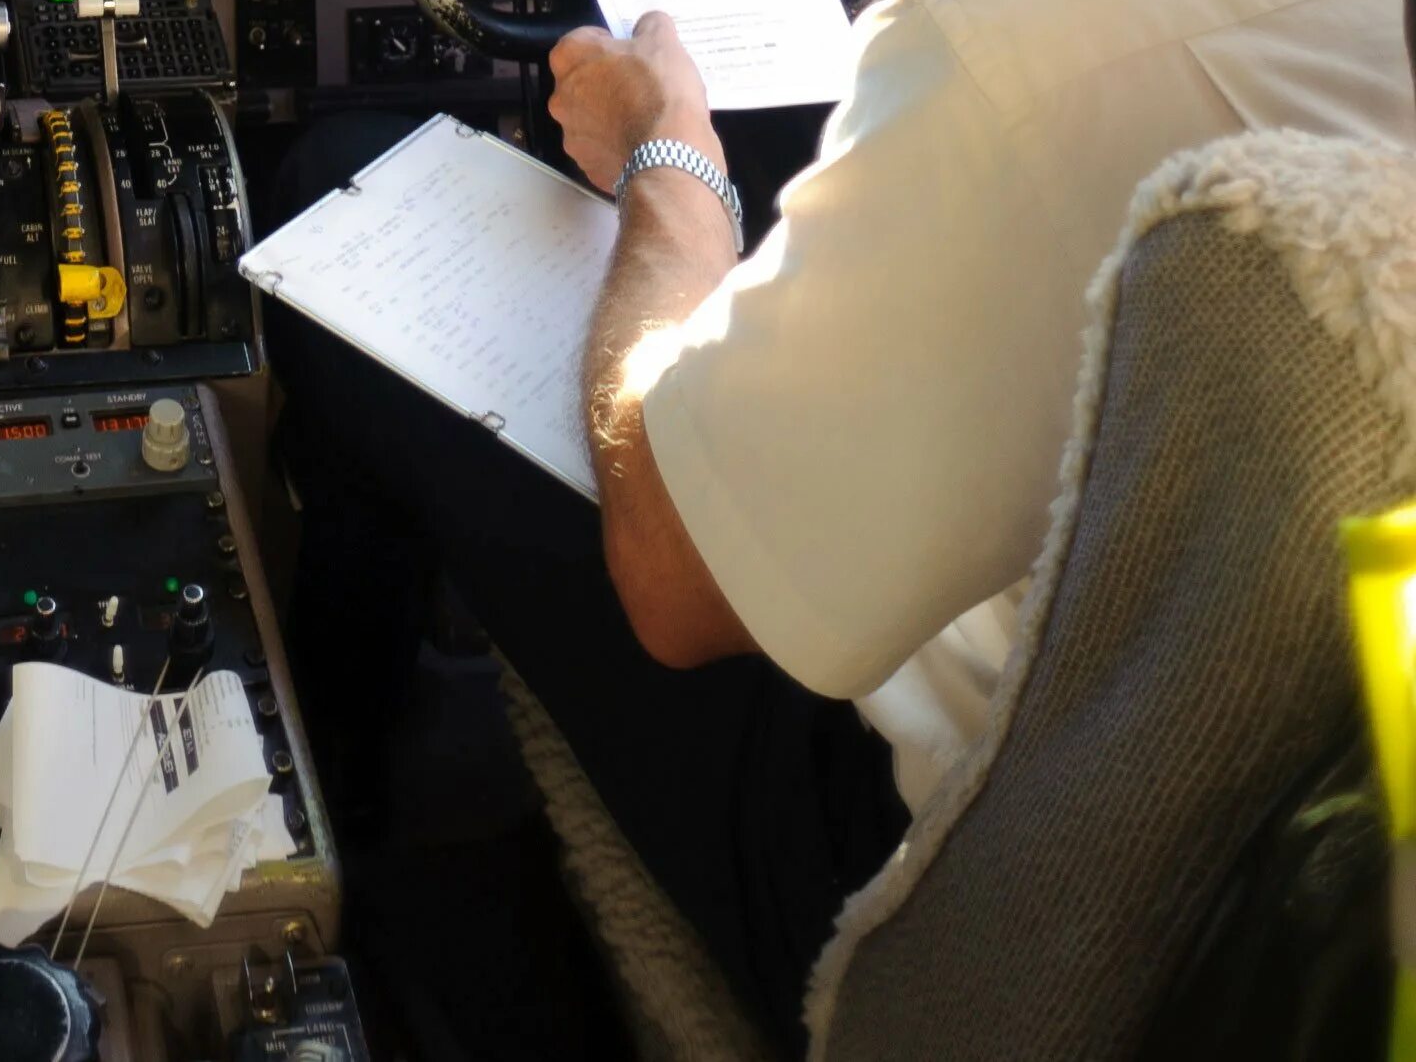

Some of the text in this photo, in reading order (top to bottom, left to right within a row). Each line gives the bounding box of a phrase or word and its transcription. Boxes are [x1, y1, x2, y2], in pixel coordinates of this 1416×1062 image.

[188, 144, 205, 153] FLAP
[121, 179, 132, 189] 40
[156, 179, 167, 189] 40
[26, 233, 40, 243] ALT
[0, 255, 17, 265] FULL
[133, 274, 153, 284] OPEN
[107, 393, 147, 404] STANDBY
